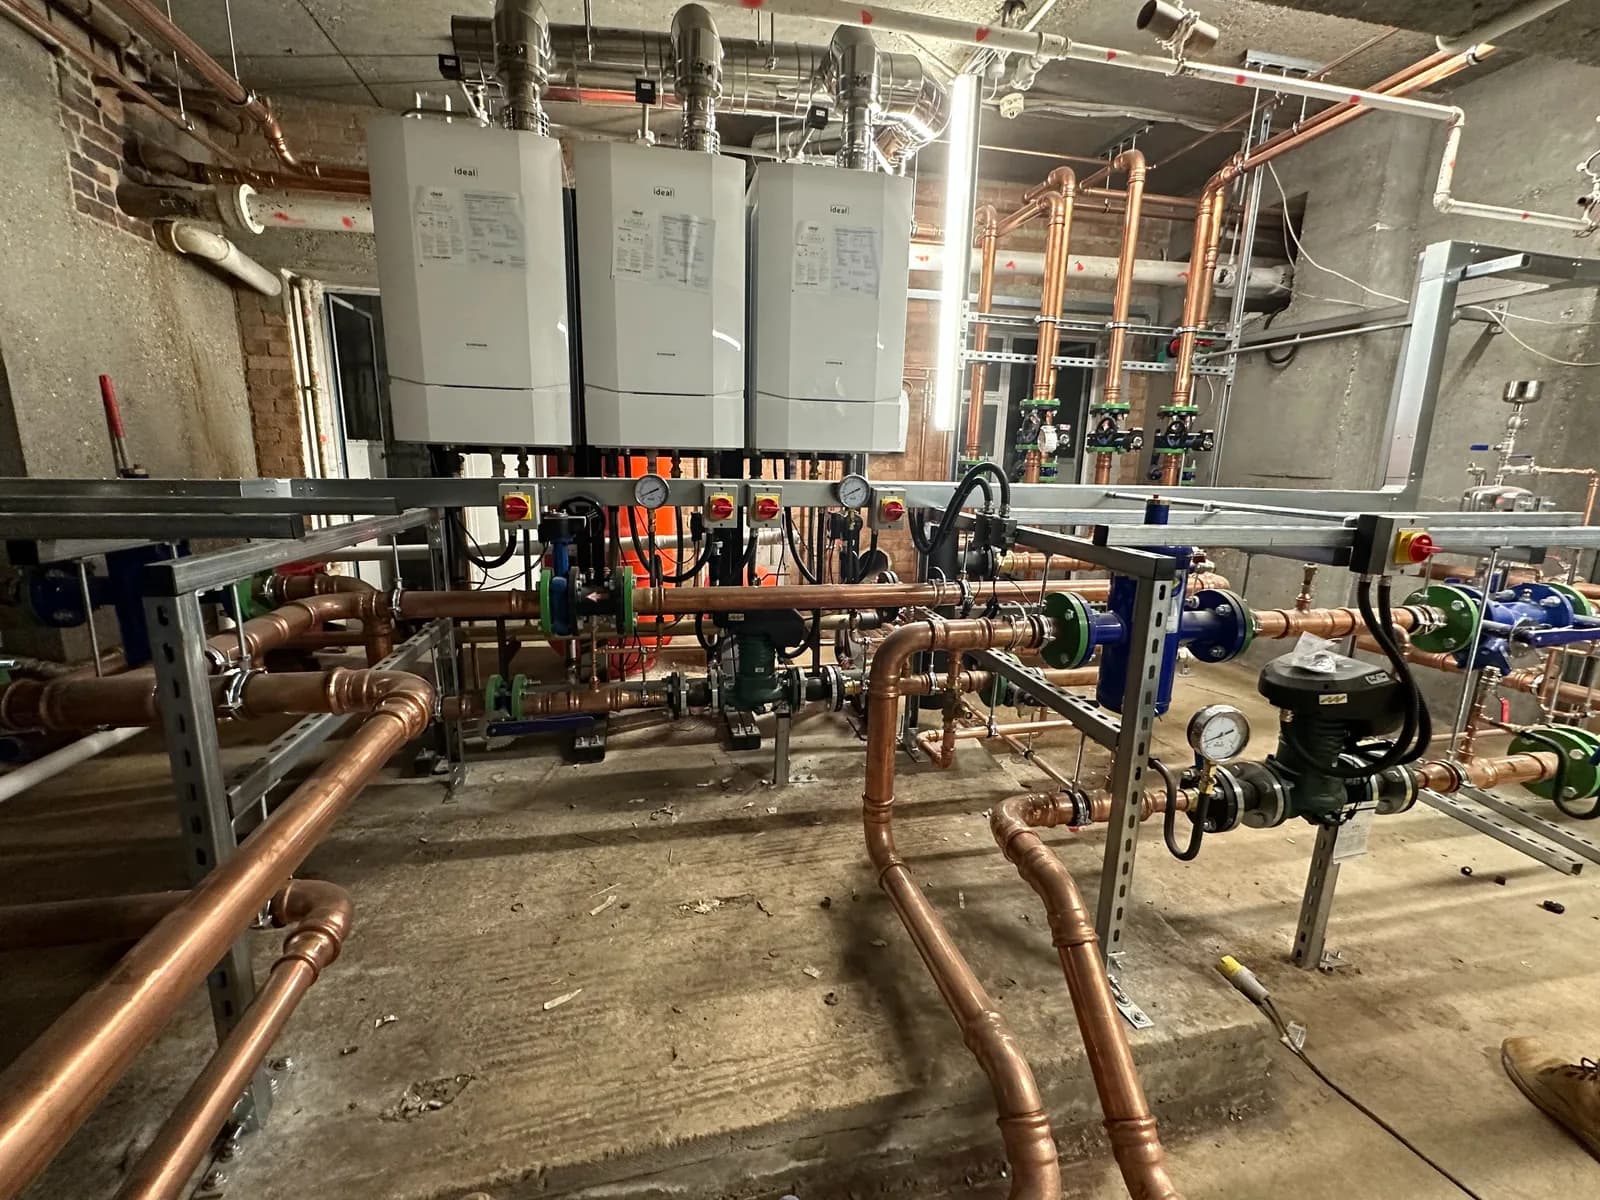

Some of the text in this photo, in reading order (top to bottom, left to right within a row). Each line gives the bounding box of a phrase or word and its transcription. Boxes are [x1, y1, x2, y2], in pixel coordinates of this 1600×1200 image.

[454, 167, 476, 177] ideal
[653, 187, 673, 197] ideal
[830, 206, 848, 215] ideal
